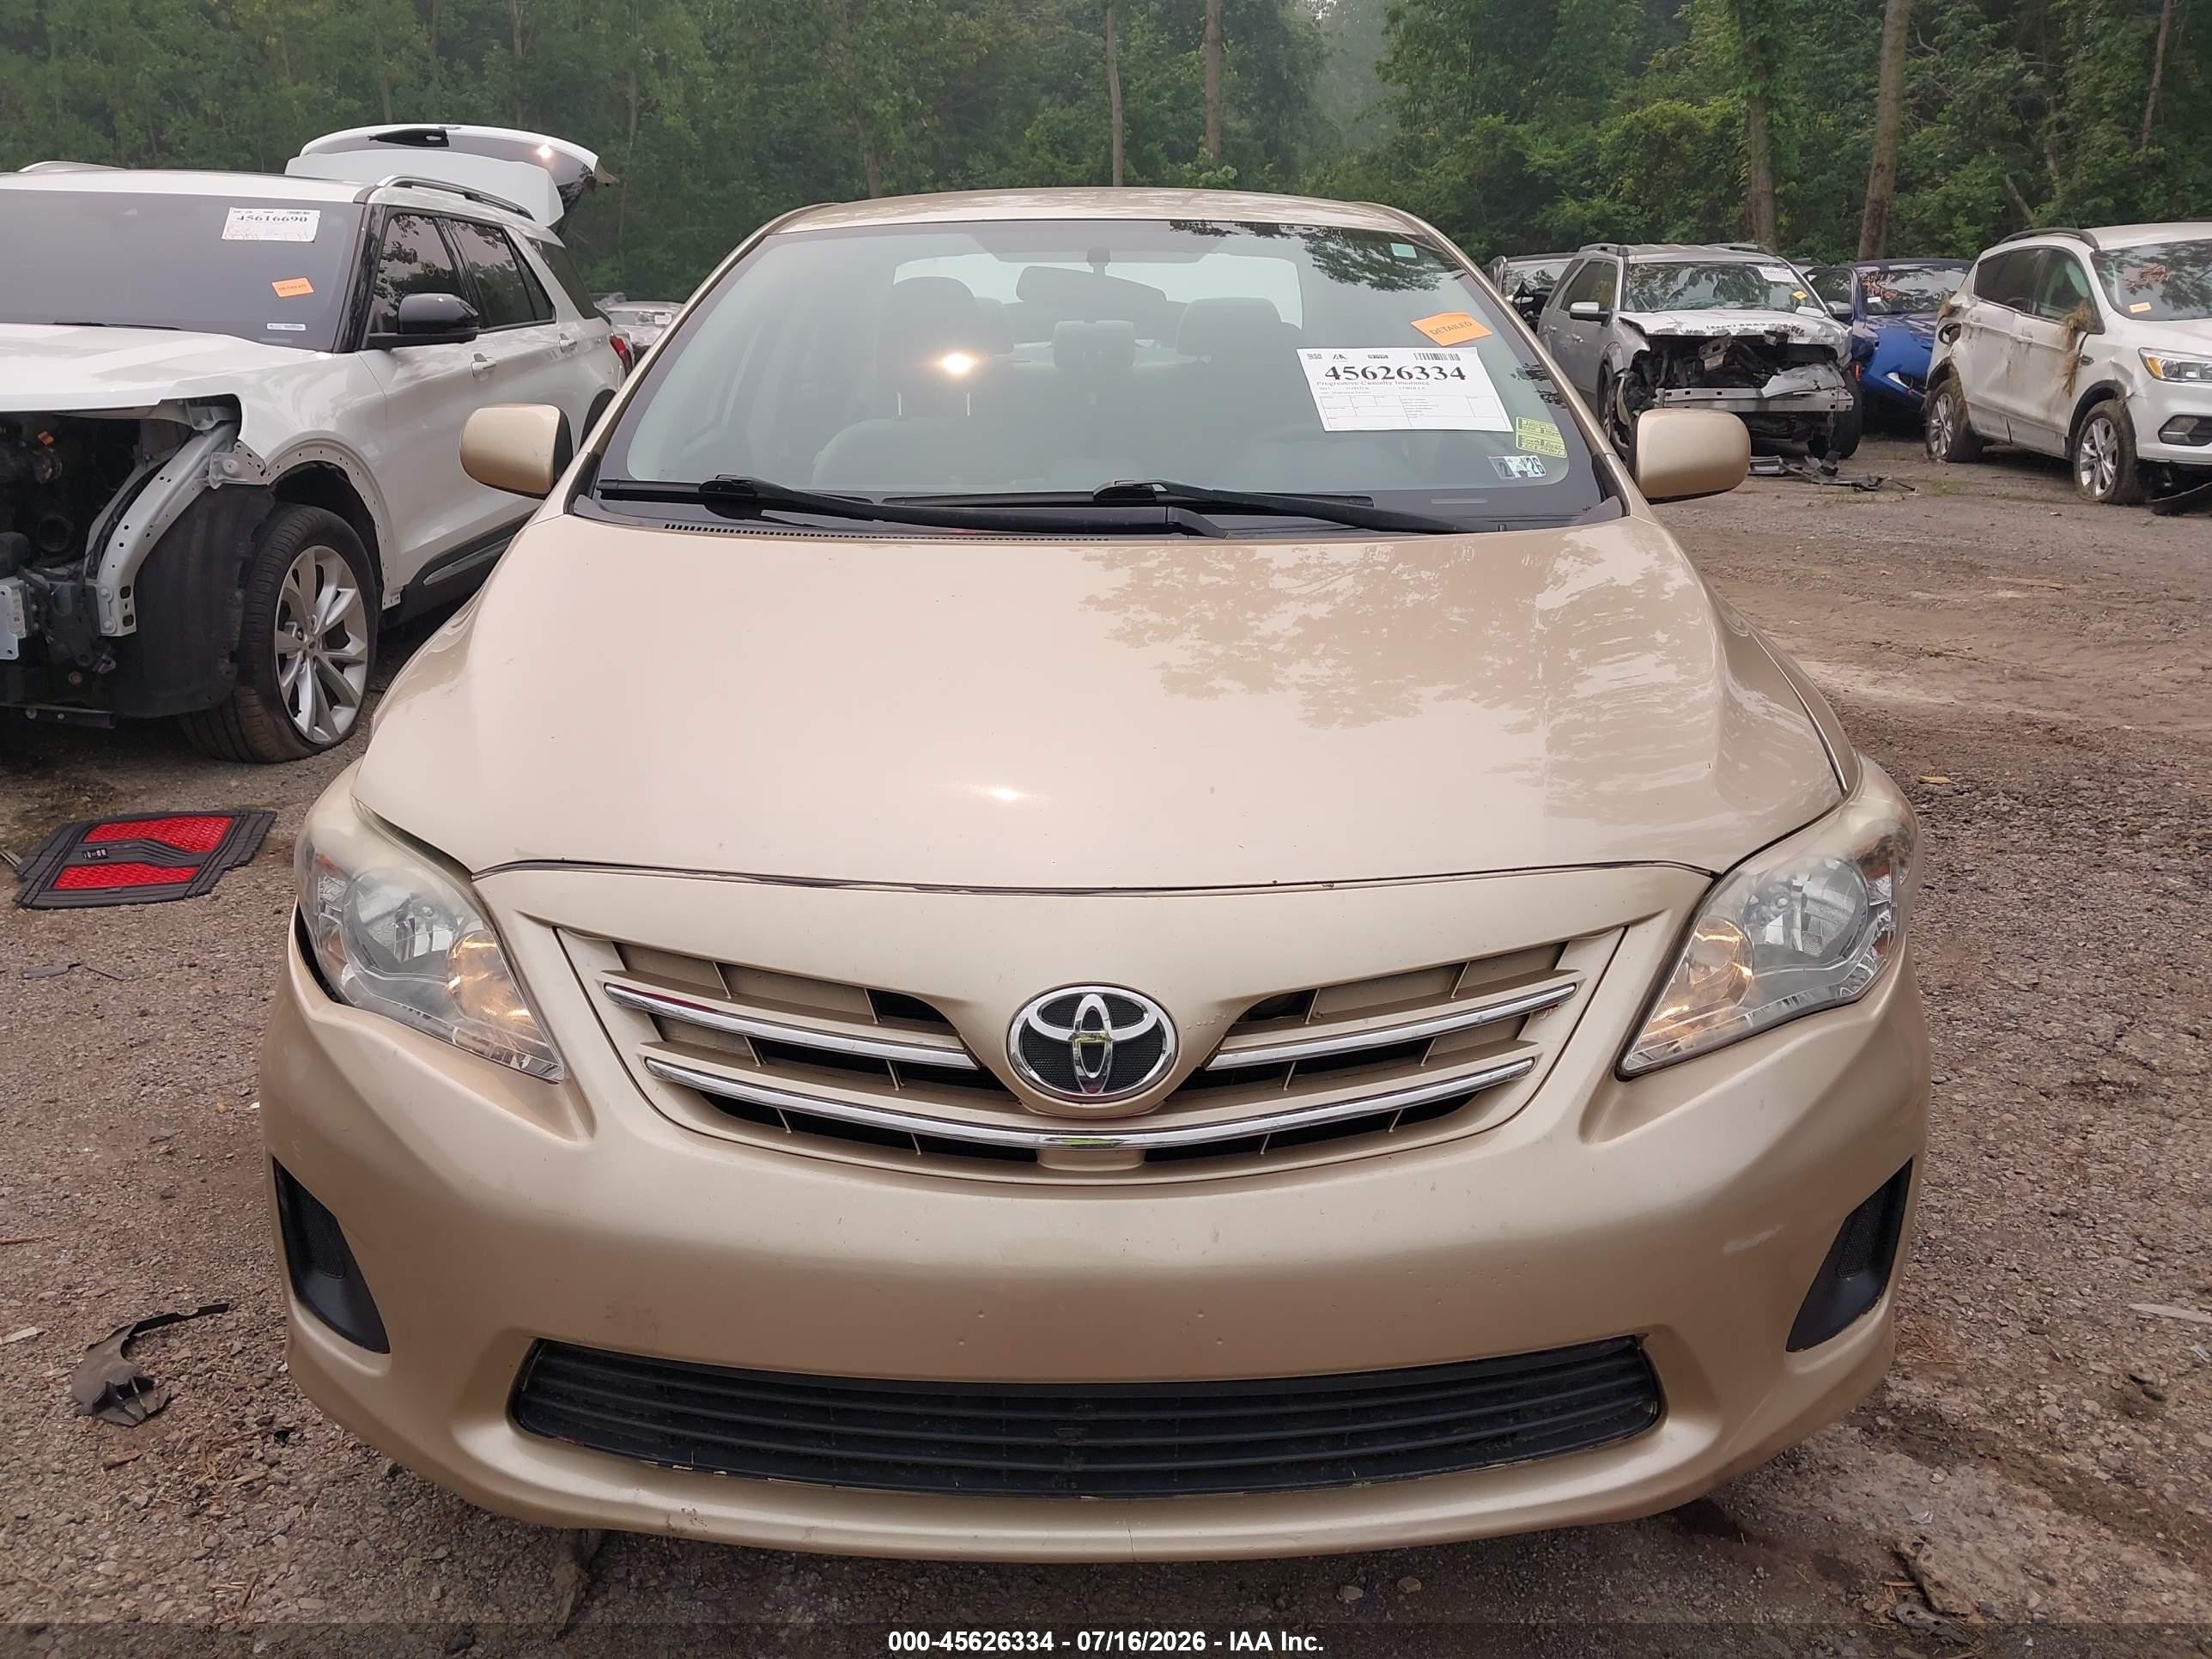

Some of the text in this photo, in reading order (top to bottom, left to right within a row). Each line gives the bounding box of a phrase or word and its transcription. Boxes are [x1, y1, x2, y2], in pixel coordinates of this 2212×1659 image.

[1429, 320, 1473, 336] DETAILED
[1325, 366, 1467, 380] 45626334
[1526, 457, 1546, 475] 26
